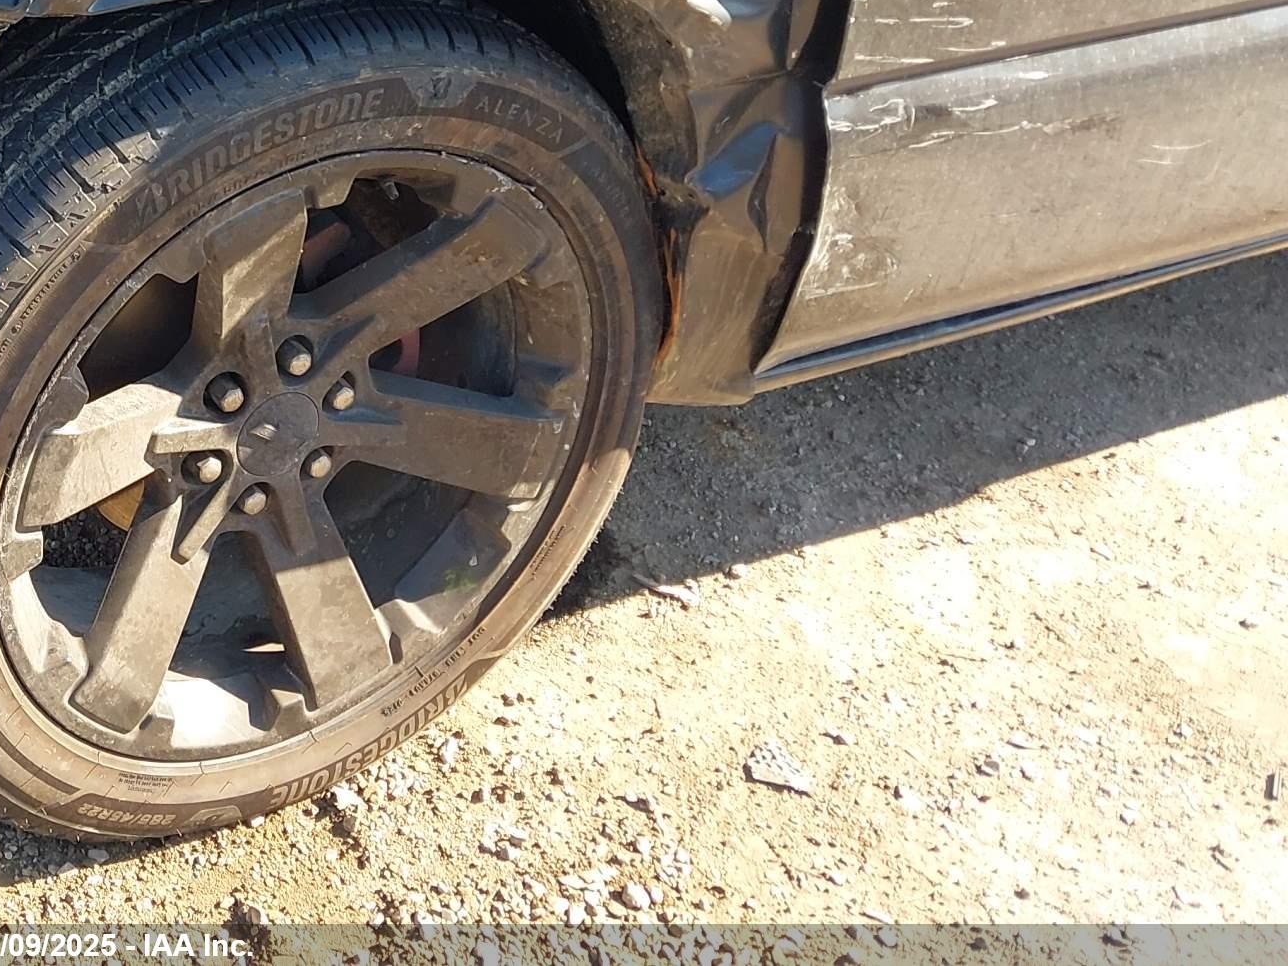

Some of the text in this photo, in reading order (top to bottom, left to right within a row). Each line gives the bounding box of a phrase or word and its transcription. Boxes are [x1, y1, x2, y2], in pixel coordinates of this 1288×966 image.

[134, 87, 385, 223] BRIDGESTONE
[476, 95, 564, 144] ALENZA
[21, 263, 68, 318] TEMPERATURE
[268, 673, 469, 809] BRIDGESTONE
[76, 802, 177, 827] 285/45R22
